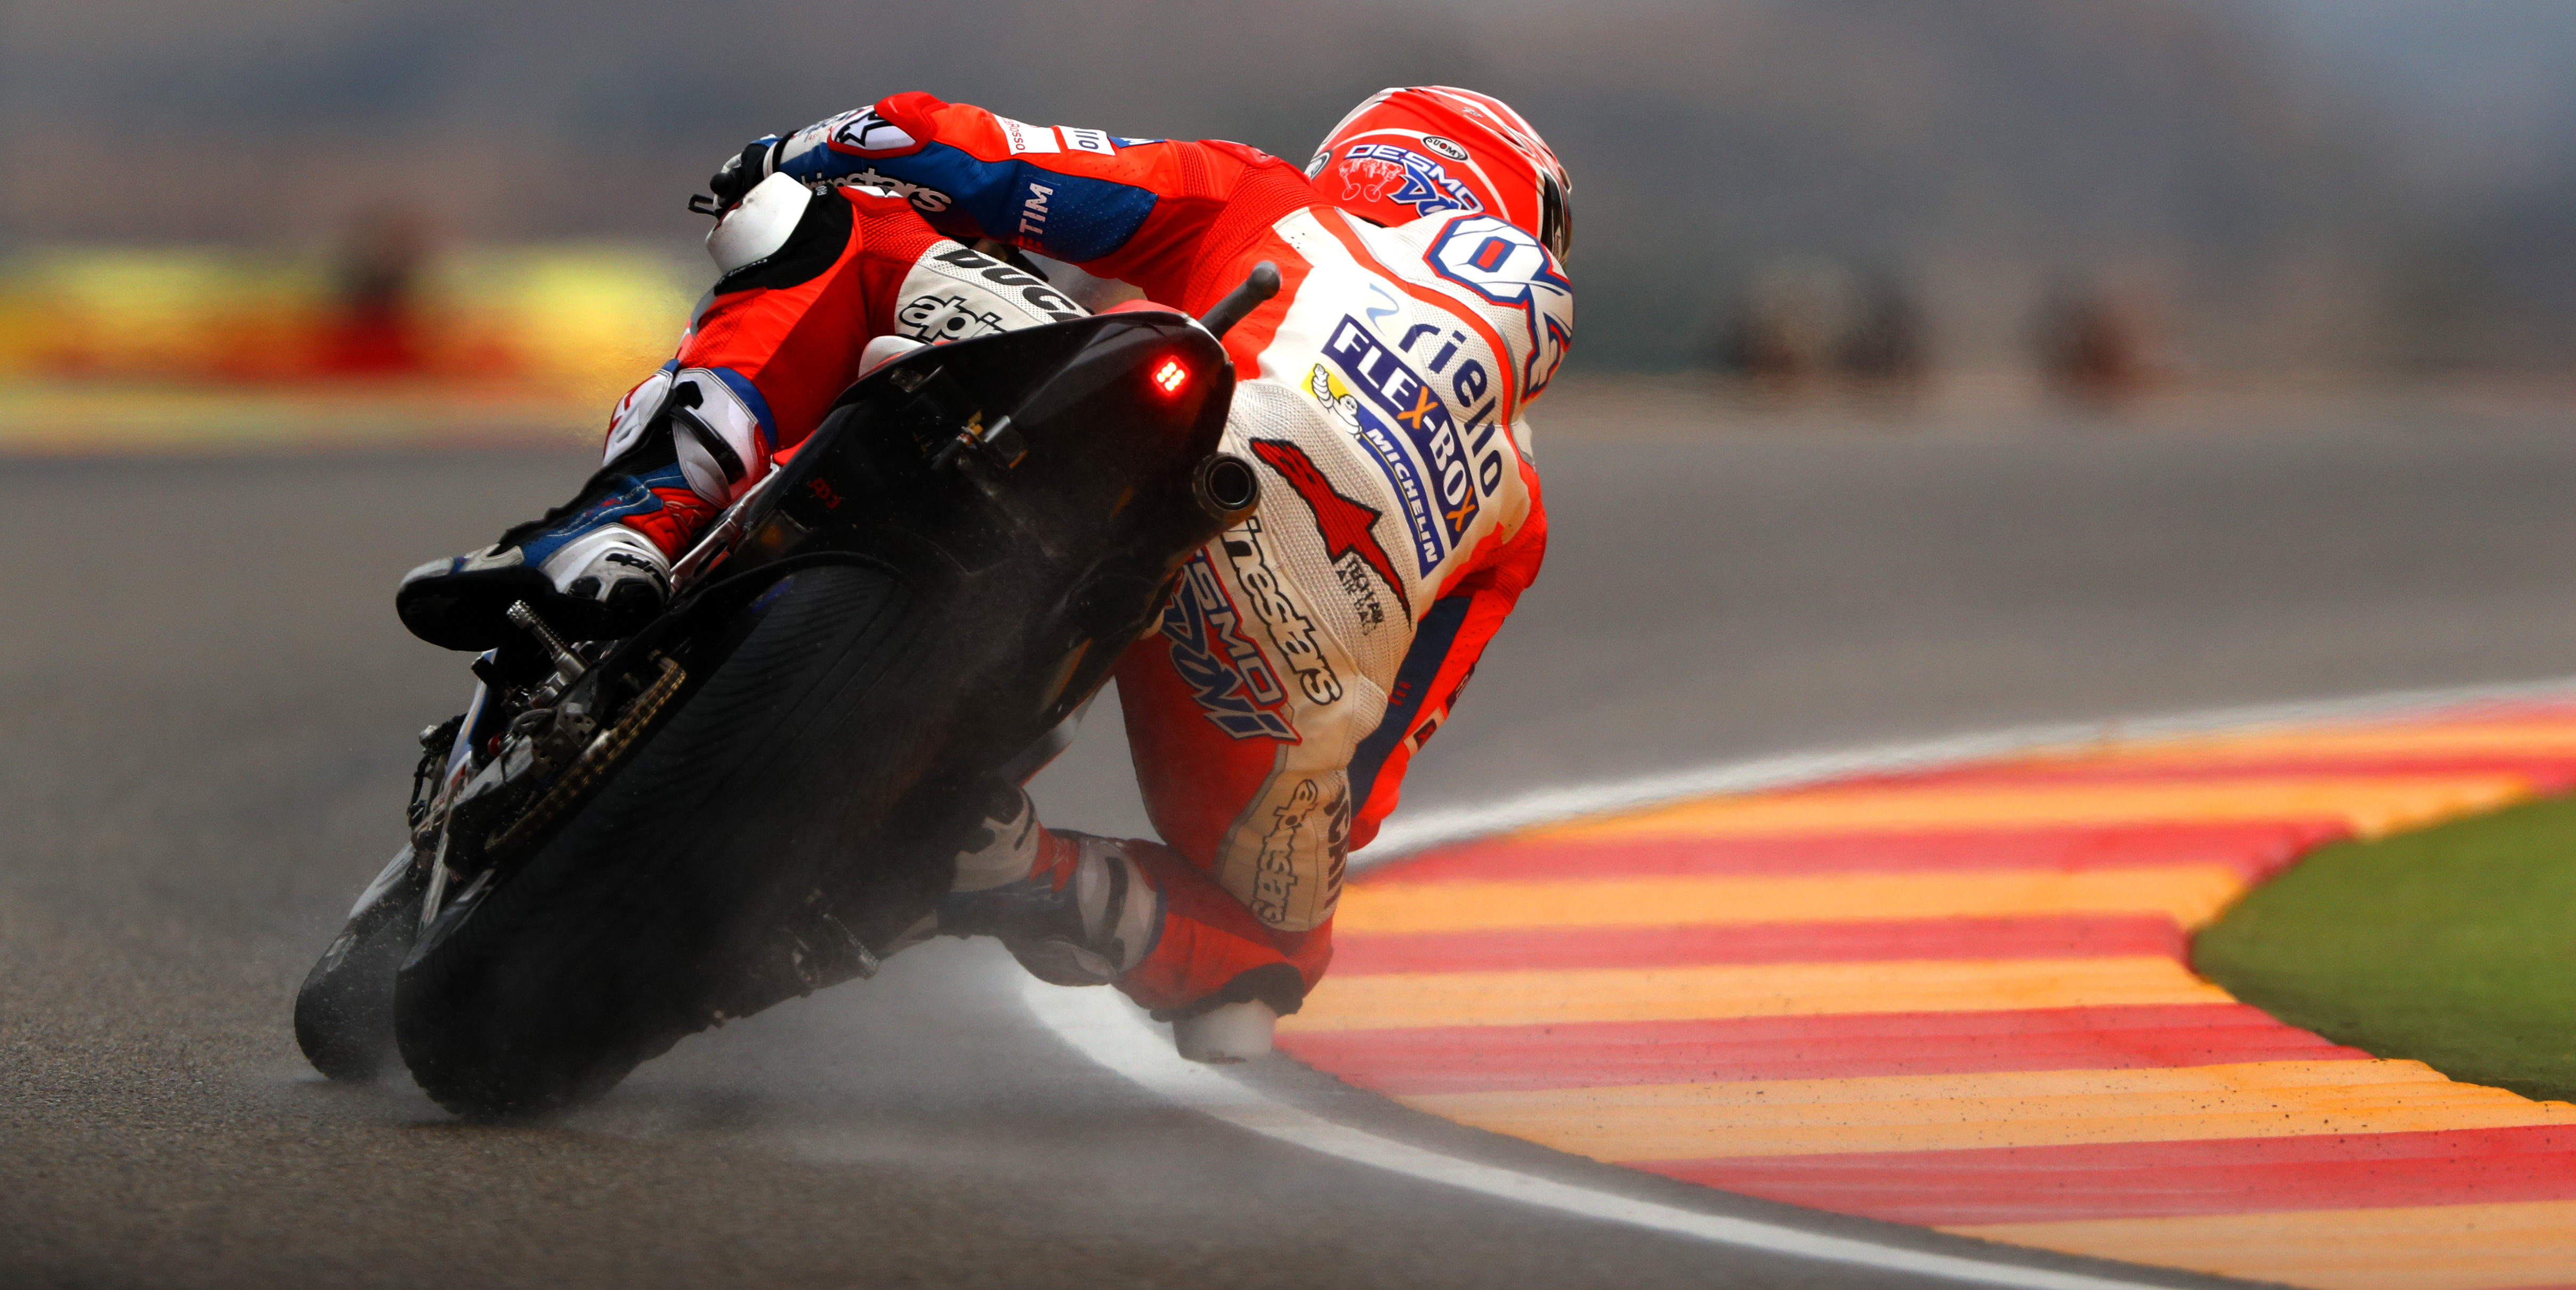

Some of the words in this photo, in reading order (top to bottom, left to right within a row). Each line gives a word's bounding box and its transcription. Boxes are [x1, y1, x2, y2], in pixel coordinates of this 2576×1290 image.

[1344, 143, 1485, 213] DESMO
[1428, 136, 1465, 160] SUOMY
[1019, 182, 1054, 235] TIM
[899, 295, 1007, 343] alpi
[1334, 321, 1476, 532] FLEX-BOX
[1366, 428, 1439, 563] MICHELIN
[1194, 549, 1286, 705] SMO
